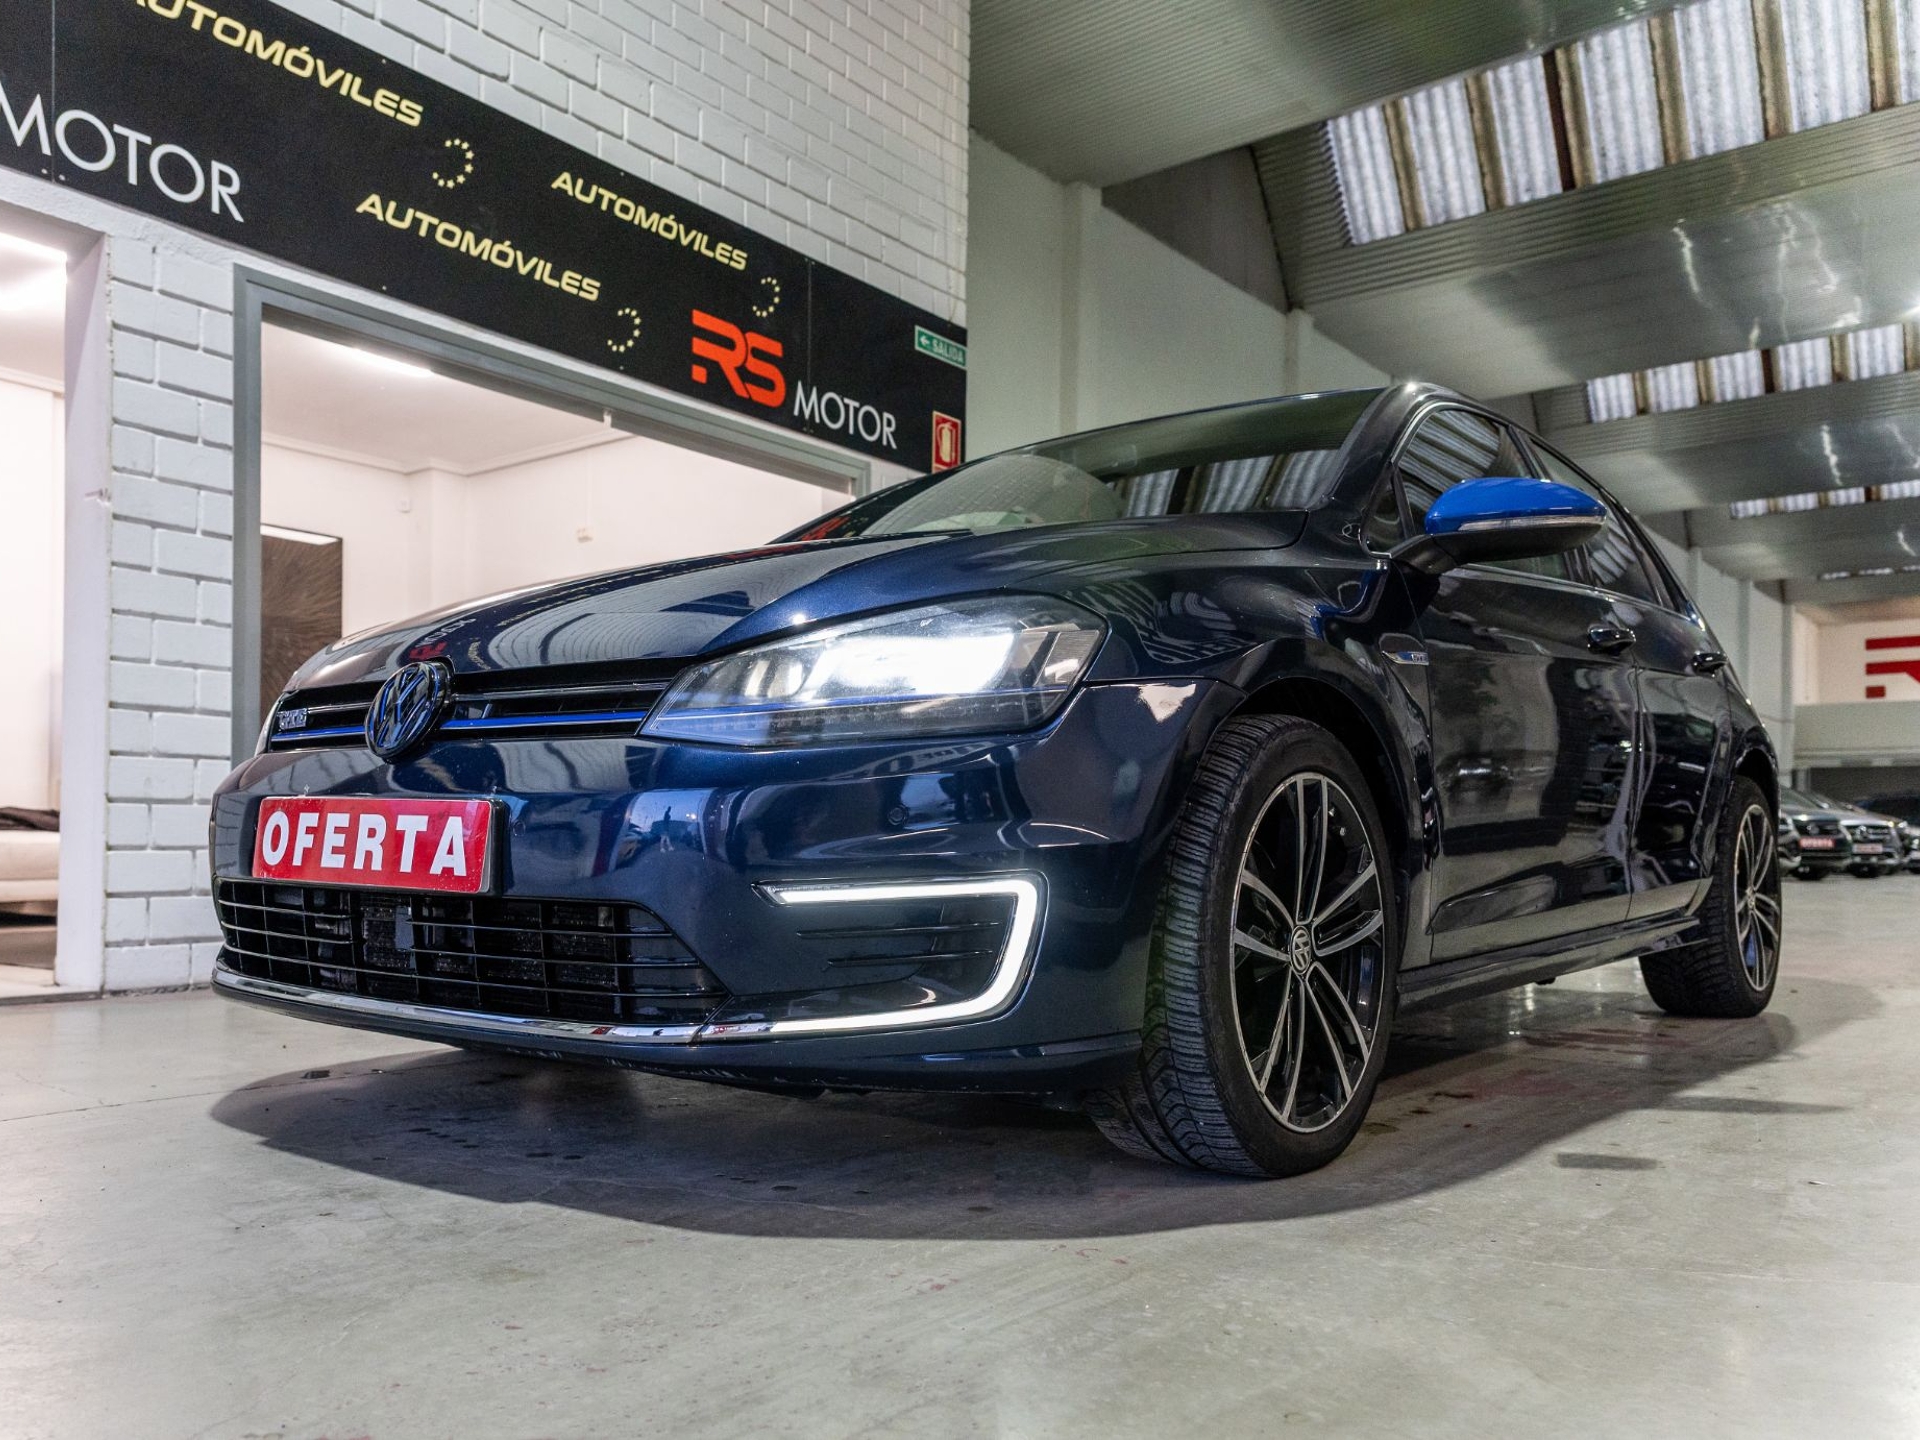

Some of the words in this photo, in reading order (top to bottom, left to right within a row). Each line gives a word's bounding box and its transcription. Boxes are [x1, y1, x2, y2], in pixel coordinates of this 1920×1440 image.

[136, 0, 424, 127] UTOMÓVILES
[0, 82, 244, 223] MOTOR
[356, 193, 601, 302] AUTOMÓVILES
[551, 172, 748, 271] AUTOMÓVILES
[691, 309, 786, 408] RS
[793, 380, 897, 449] MOTOR
[931, 338, 964, 363] SALIDA
[263, 810, 467, 876] OFERTA
